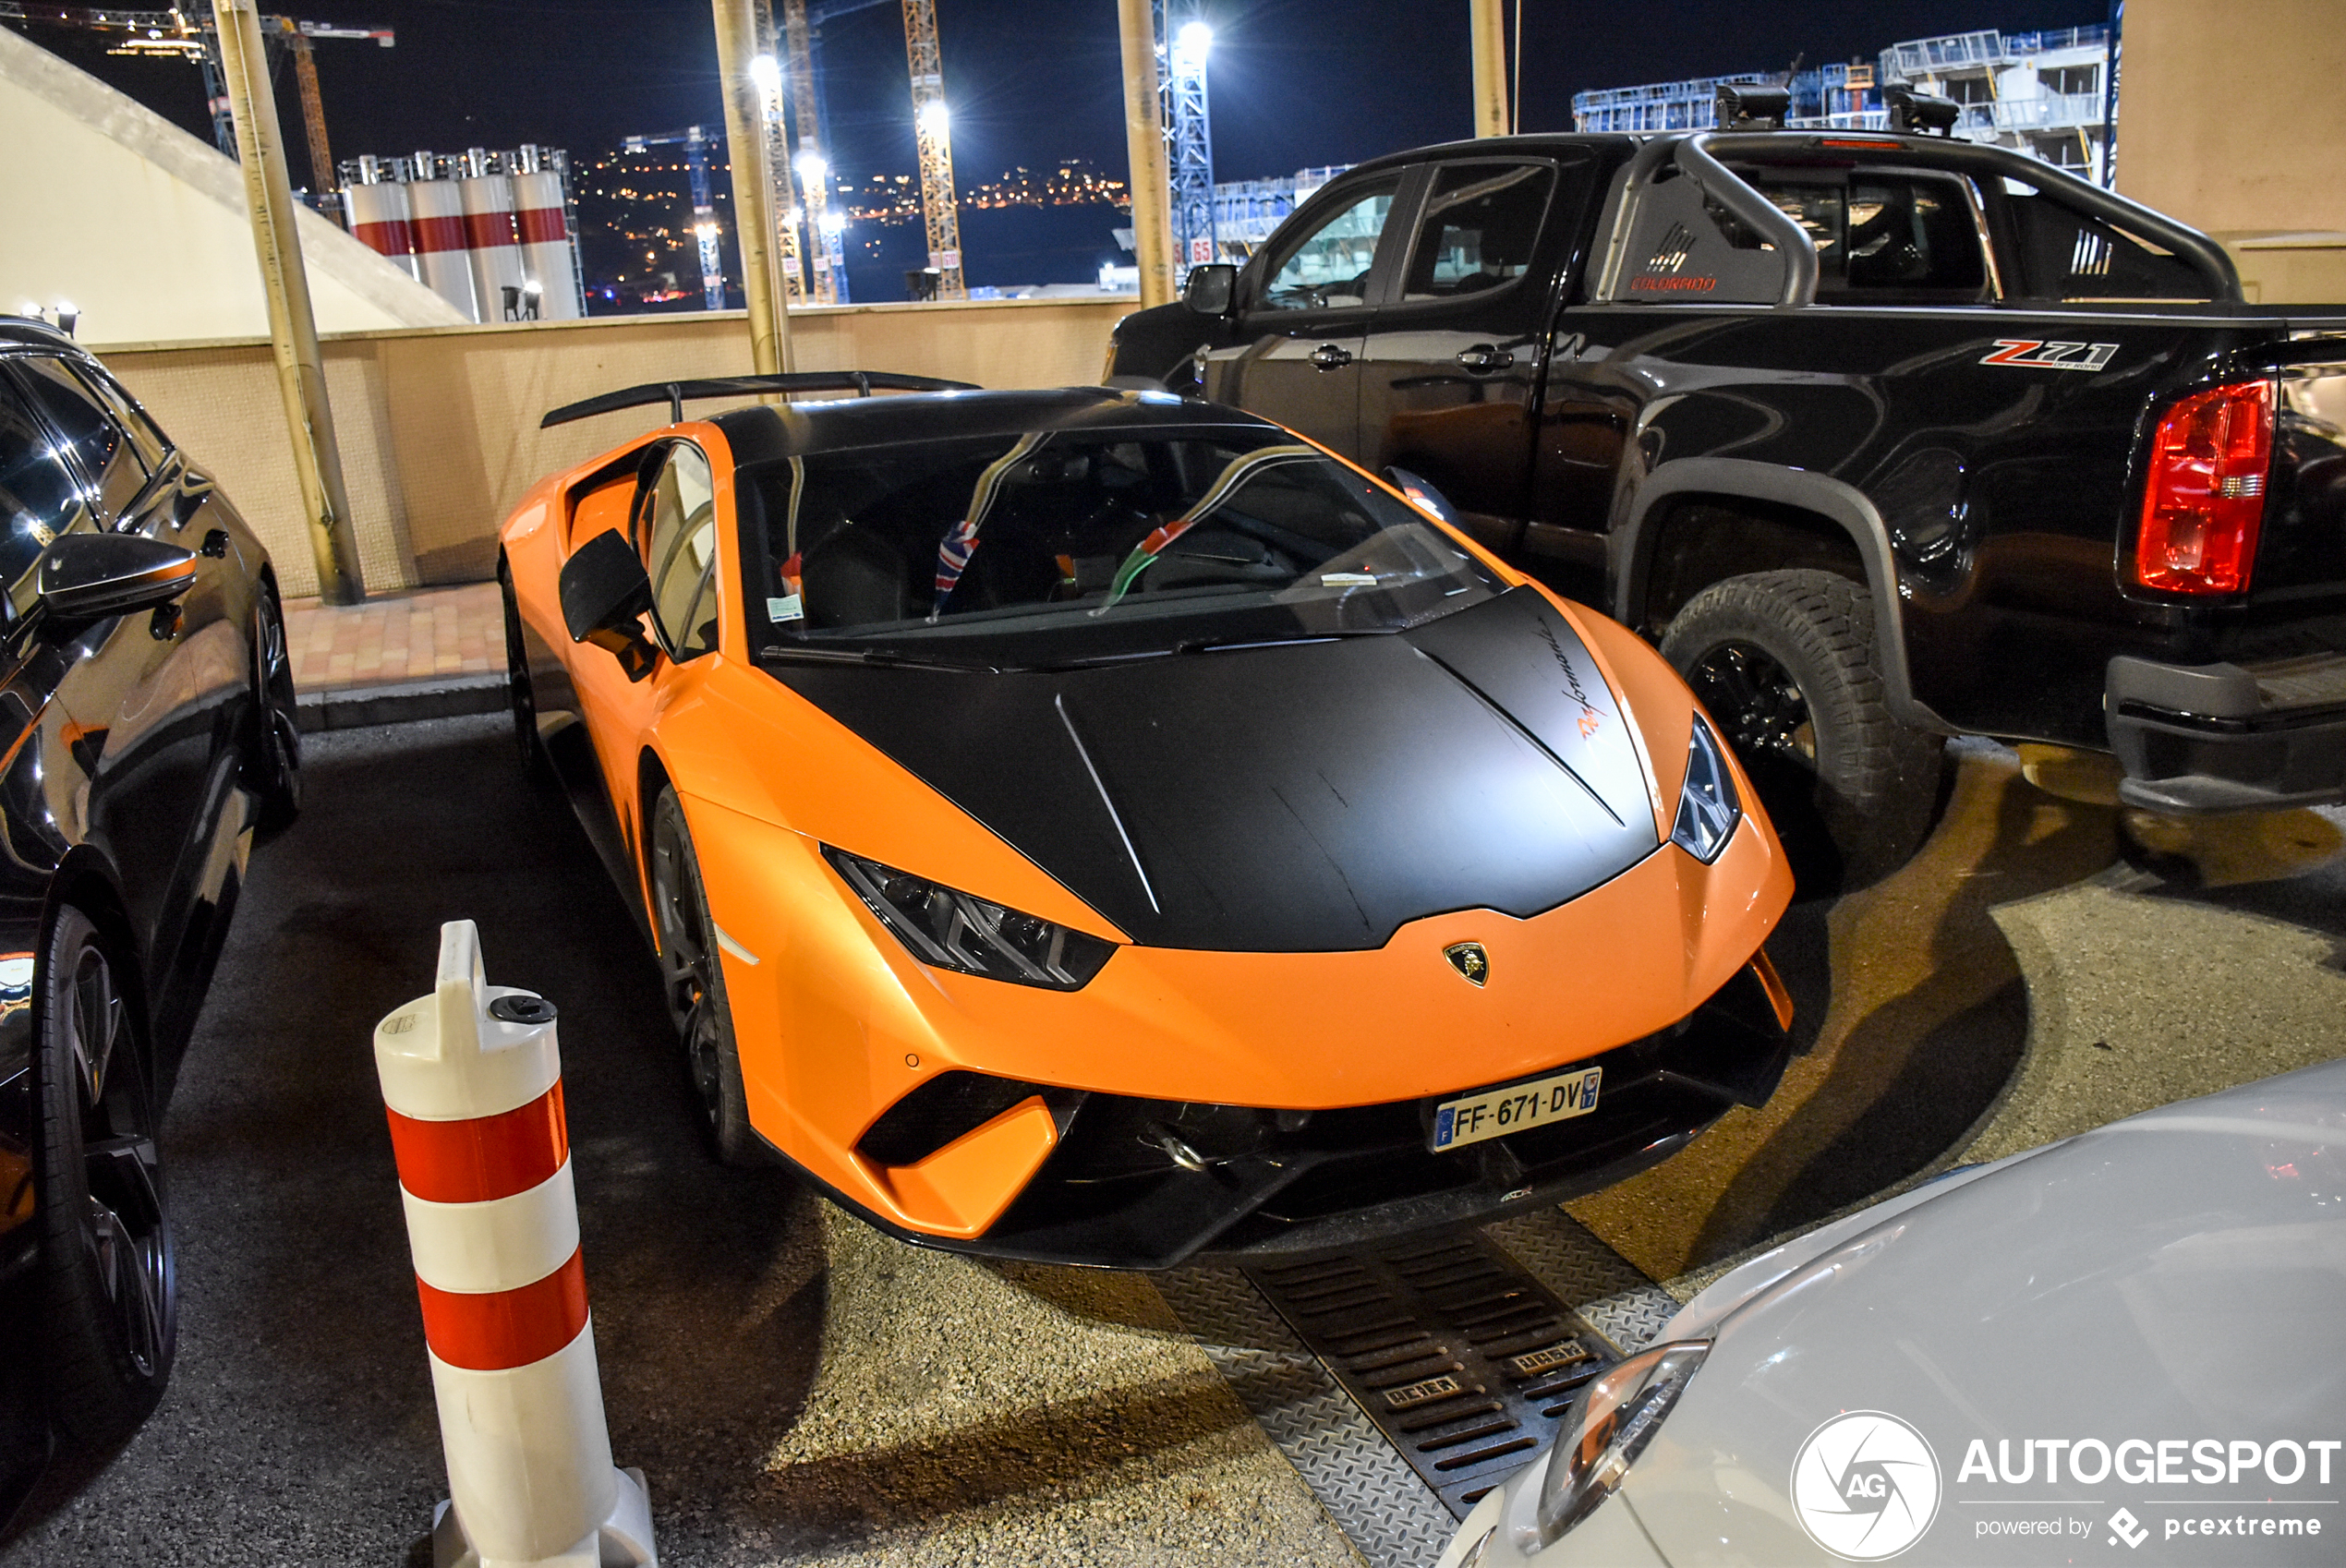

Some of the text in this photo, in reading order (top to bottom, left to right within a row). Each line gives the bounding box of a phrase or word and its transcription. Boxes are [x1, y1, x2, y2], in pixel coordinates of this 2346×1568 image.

[1193, 242, 1210, 261] G5
[1630, 277, 1716, 291] COLORADO
[1978, 339, 2120, 368] Z71
[1455, 1080, 1581, 1137] FF-671-DV
[1581, 1092, 1595, 1108] 17
[1441, 1129, 1448, 1141] F
